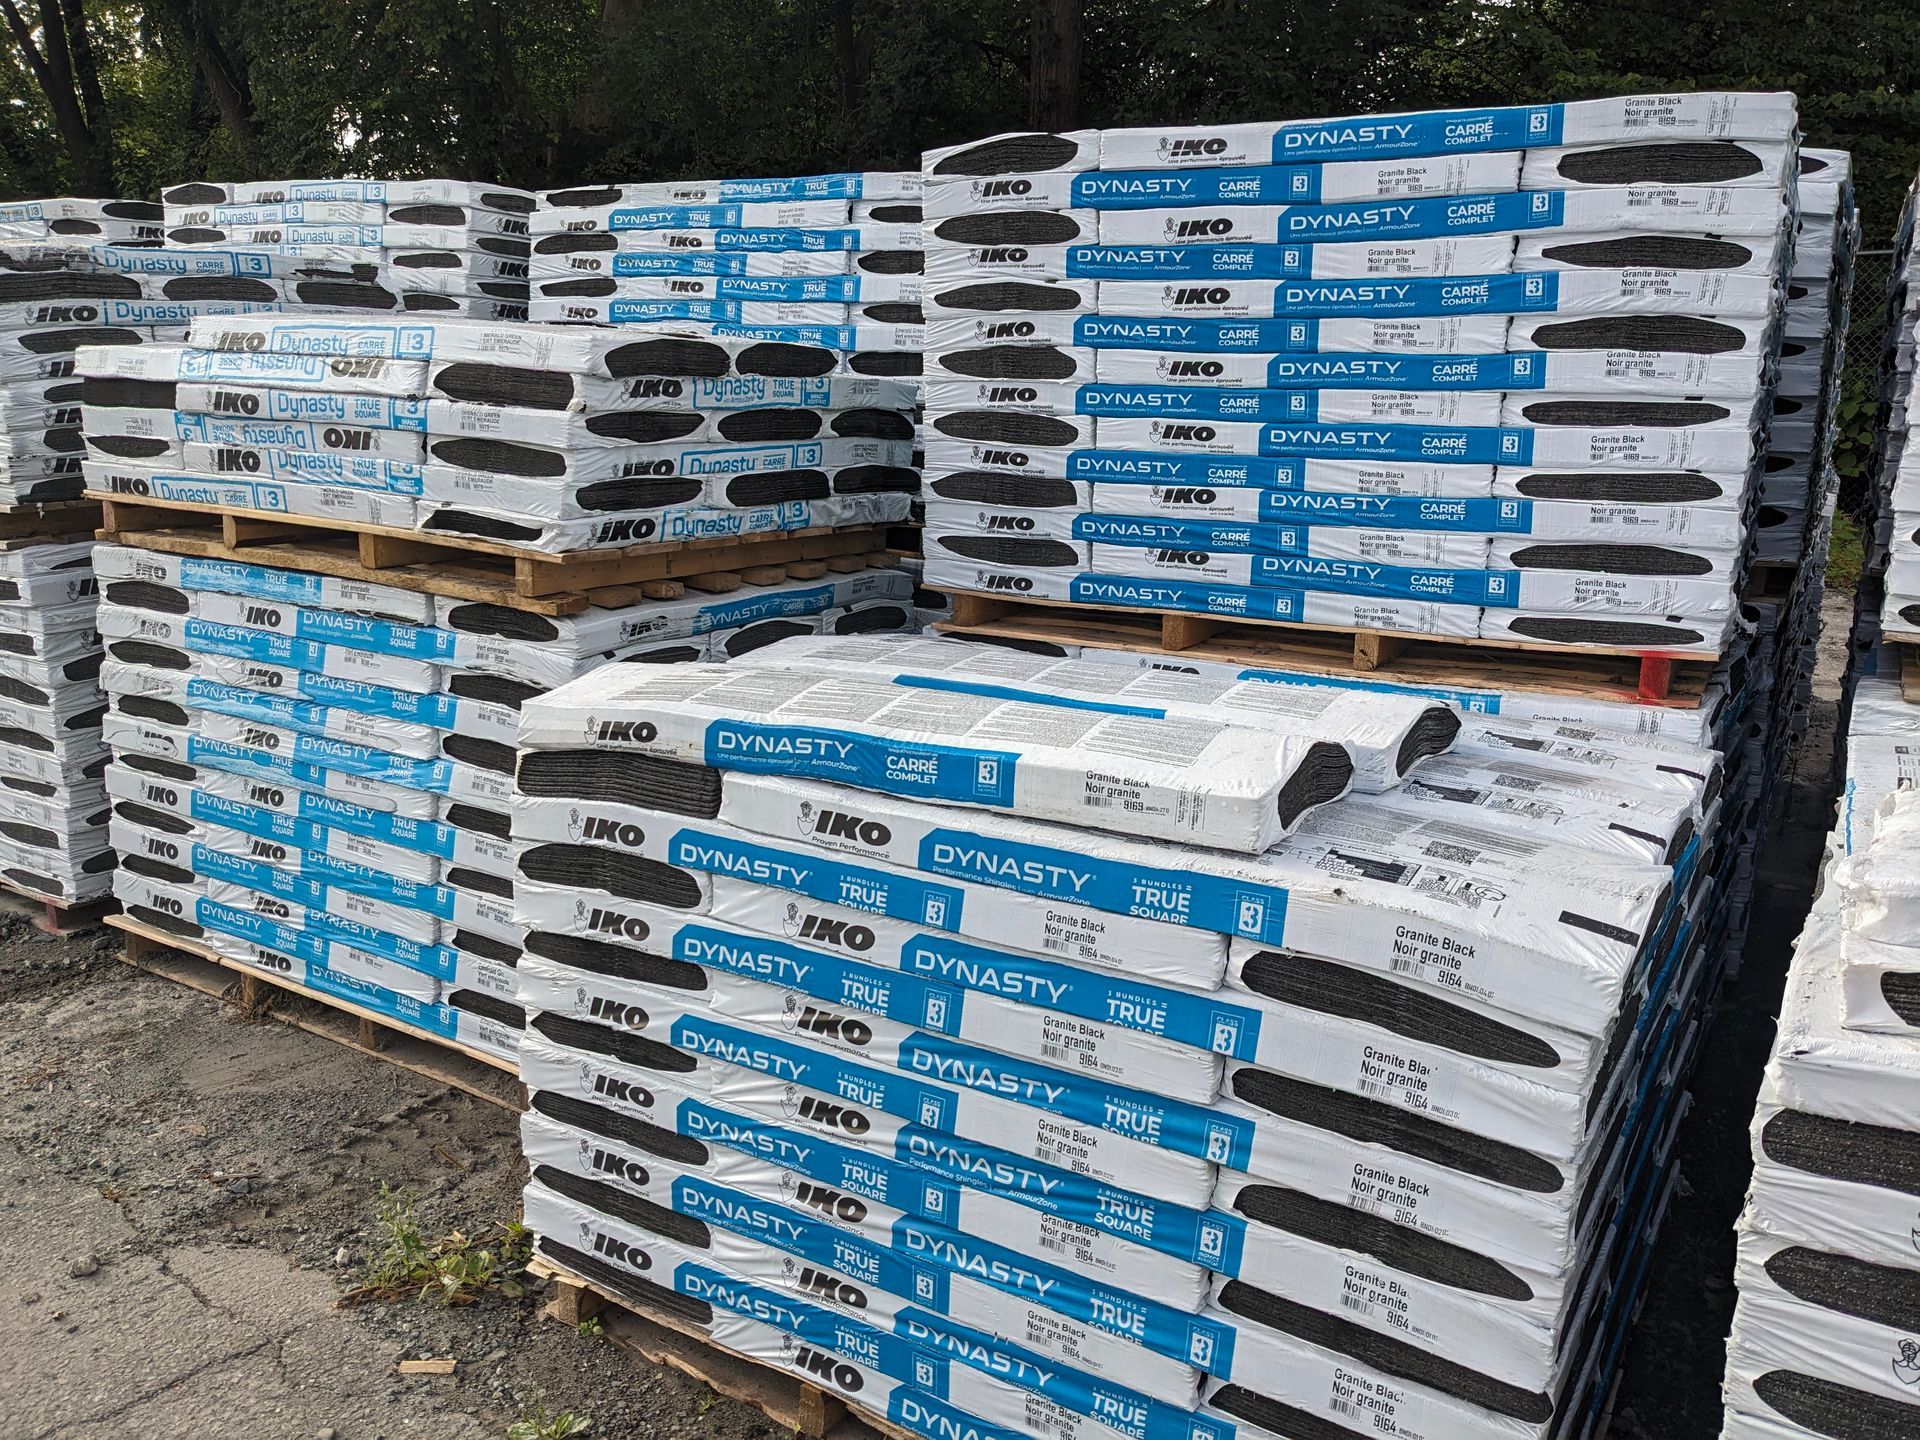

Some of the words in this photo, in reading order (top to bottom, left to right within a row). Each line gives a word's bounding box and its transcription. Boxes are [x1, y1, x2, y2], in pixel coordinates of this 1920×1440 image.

[1625, 98, 1655, 107] Granite
[1658, 97, 1682, 106] Black
[1624, 107, 1641, 117] Noir
[1644, 107, 1674, 117] granite
[1284, 124, 1410, 148] DYNASTY
[1445, 120, 1494, 136] CARRÉ
[1444, 133, 1493, 145] COMPLET
[1171, 138, 1228, 156] IKO
[1378, 169, 1405, 177] Granite
[1407, 167, 1427, 176] Black
[1378, 177, 1392, 185] Noir
[1394, 176, 1420, 185] granite
[982, 180, 1032, 197] IKO
[1082, 180, 1191, 193] DYNASTY
[1219, 190, 1260, 198] COMPLET
[1407, 184, 1423, 192] 9169
[1628, 190, 1644, 198] Noir
[1647, 189, 1676, 198] granite
[1661, 197, 1679, 206] 9169
[184, 211, 209, 224] IKO
[219, 206, 258, 224] Dynasty
[290, 205, 299, 217] 3
[614, 214, 674, 224] DYNASTY
[688, 213, 711, 222] TRUE
[1290, 206, 1416, 230] DYNASTY
[566, 219, 597, 232] IKO
[1177, 218, 1232, 236] IKO
[721, 234, 787, 245] DYNASTY
[979, 248, 1028, 262] IKO
[1077, 250, 1185, 264] DYNASTY
[1368, 249, 1394, 257] Granite
[1396, 248, 1416, 256] Black
[105, 253, 187, 275] Dynasty
[250, 257, 262, 272] 3
[618, 259, 679, 269] DYNASTY
[671, 281, 704, 292] IKO
[723, 279, 788, 292] DYNASTY
[1286, 284, 1410, 303] DYNASTY
[1622, 279, 1638, 287] Noir
[1641, 279, 1669, 289] granite
[1174, 288, 1231, 304] IKO
[36, 304, 98, 322] IKO
[116, 302, 197, 322] Dynasty
[614, 304, 675, 314] DYNASTY
[219, 331, 266, 352] IKO
[280, 331, 349, 355] Dynasty
[413, 333, 424, 349] 3
[330, 358, 381, 380] IKO
[629, 380, 683, 398] IKO
[773, 380, 795, 389] TRUE
[773, 389, 794, 397] SQUARE
[214, 392, 259, 415] IKO
[989, 388, 1037, 402] IKO
[1086, 392, 1191, 406] DYNASTY
[278, 392, 345, 419] Dynasty
[355, 398, 381, 408] TRUE
[355, 408, 381, 418] SQUARE
[324, 428, 370, 450] IKO
[1163, 425, 1216, 441] IKO
[1591, 436, 1621, 445] Granite
[1623, 435, 1645, 444] Black
[1591, 445, 1609, 453] Noir
[1610, 444, 1637, 453] granite
[1624, 453, 1640, 461] 9169
[218, 450, 260, 472] IKO
[1077, 458, 1181, 475] DYNASTY
[112, 476, 149, 497] IKO
[160, 482, 219, 501] Dynasty
[268, 490, 279, 506] 3
[1161, 489, 1216, 504] IKO
[601, 518, 655, 542] IKO
[672, 513, 743, 535] Dynasty
[1080, 583, 1183, 601] DYNASTY
[1575, 579, 1603, 589] Granite
[1605, 580, 1627, 589] Black
[246, 607, 281, 627] IKO
[304, 613, 373, 632] DYNASTY
[390, 627, 416, 638] TRUE
[390, 638, 416, 648] SQUARE
[599, 720, 658, 743] IKO
[718, 731, 854, 758] DYNASTY
[887, 755, 938, 774] CARRÉ
[886, 771, 938, 784] COMPLET
[1086, 771, 1121, 785] Granite
[1123, 776, 1150, 789] Black
[148, 785, 178, 806] IKO
[251, 786, 284, 806] IKO
[1085, 782, 1104, 796] Noir
[1107, 785, 1140, 799] granite
[197, 793, 257, 818] DYNASTY
[272, 815, 294, 827] TRUE
[306, 797, 374, 818] DYNASTY
[1123, 800, 1144, 811] 9169
[272, 825, 294, 836] SQUARE
[582, 817, 645, 846] IKO
[815, 812, 892, 847] IKO
[812, 836, 835, 847] Proven
[839, 841, 890, 858] Performance
[680, 844, 808, 885] DYNASTY
[933, 845, 1092, 891] DYNASTY
[1133, 887, 1191, 911] TRUE
[153, 895, 182, 915] IKO
[1130, 905, 1188, 924] SQUARE
[202, 906, 260, 929] DYNASTY
[588, 909, 651, 941] IKO
[1045, 910, 1079, 928] Granite
[1082, 919, 1105, 934] Black
[1242, 905, 1262, 930] 3
[799, 914, 876, 951] IKO
[1045, 923, 1065, 938] Noir
[1066, 929, 1096, 945] granite
[1396, 926, 1439, 947] Granite
[1444, 940, 1475, 958] Black
[258, 950, 291, 972] IKO
[684, 938, 810, 979] DYNASTY
[1079, 944, 1097, 959] 9164
[1393, 938, 1417, 958] Noir
[1421, 950, 1461, 970] granite
[915, 949, 1070, 1003] DYNASTY
[1107, 998, 1166, 1029] TRUE
[1438, 971, 1462, 988] 9164
[1044, 1016, 1075, 1034] Granite
[1079, 1025, 1104, 1040] Black
[1042, 1028, 1061, 1044] Noir
[1065, 1035, 1096, 1052] granite
[594, 1073, 655, 1107] IKO
[1404, 1091, 1428, 1110] 9164
[688, 1111, 811, 1162] DYNASTY
[910, 1137, 1059, 1194] DYNASTY
[1098, 1197, 1154, 1227] TRUE
[1354, 1163, 1394, 1187] Granite
[1398, 1174, 1430, 1196] Black
[1007, 1189, 1058, 1210] ArmourZone
[1094, 1214, 1152, 1240] SQUARE
[798, 1268, 867, 1308] IKO
[835, 1331, 879, 1358] TRUE
[909, 1321, 1052, 1386] DYNASTY
[796, 1347, 863, 1392] IKO
[1374, 1416, 1396, 1432] 9164
